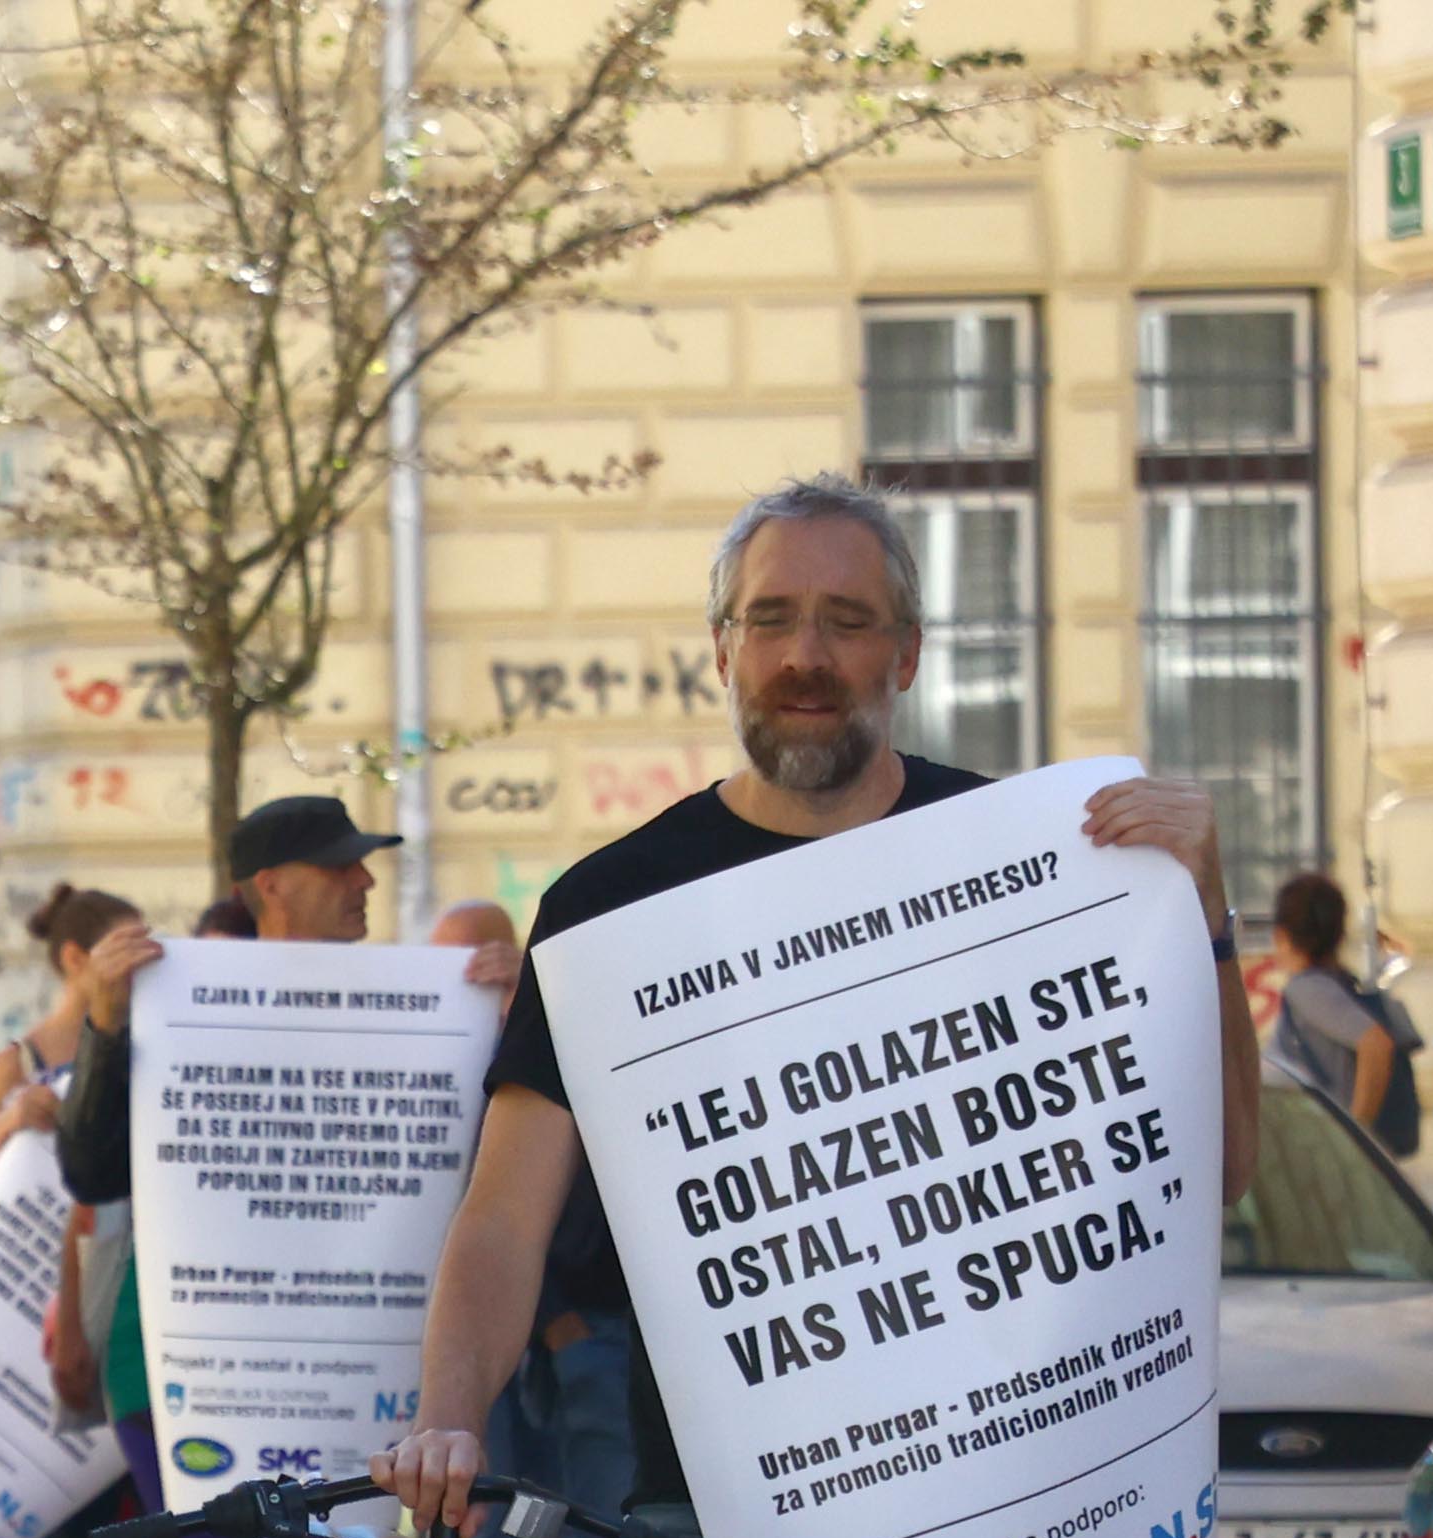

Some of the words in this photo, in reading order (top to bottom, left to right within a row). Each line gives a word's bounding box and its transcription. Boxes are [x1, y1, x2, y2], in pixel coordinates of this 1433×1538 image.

[192, 987, 250, 1006] IZJAVA
[257, 988, 266, 1006] V
[272, 990, 341, 1009] JAVNEM
[348, 992, 440, 1012] INTERESU?
[633, 958, 739, 1018] IZJAVA
[741, 948, 762, 979] V
[773, 906, 894, 971] JAVNEM
[898, 850, 1058, 930] INTERESU?
[162, 1088, 184, 1110] ŠE
[192, 1091, 274, 1113] POSEBEJ
[280, 1095, 304, 1114] NA
[312, 1097, 359, 1116] TISTE
[368, 1098, 377, 1116] V
[178, 1118, 201, 1137] DA
[210, 1119, 231, 1138] SE
[239, 1120, 314, 1141] AKTIVNO
[322, 1122, 398, 1142] UPREMO
[406, 1125, 449, 1144] LGBT
[280, 1069, 304, 1087] NA
[312, 1070, 344, 1089] VSE
[645, 1076, 769, 1153] “LEJ
[779, 994, 1020, 1115] GOLAZEN
[1029, 955, 1148, 1032] STE,
[675, 1102, 944, 1238] GOLAZEN
[951, 1033, 1147, 1148] BOSTE
[158, 1143, 258, 1165] IDEOLOGIJI
[267, 1147, 283, 1165] IN
[292, 1147, 400, 1169] ZAHTEVAMO
[198, 1170, 282, 1192] POPOLNO
[290, 1173, 307, 1193] IN
[315, 1173, 421, 1196] TAKOJŠNJO
[696, 1216, 881, 1310] OSTAL,
[886, 1138, 1096, 1248] DOKLER
[1104, 1107, 1171, 1174] SE
[723, 1302, 846, 1387] VAS
[856, 1269, 946, 1346] NE
[956, 1178, 1183, 1312] SPUCA.”
[757, 1436, 842, 1481] Urban
[845, 1403, 939, 1453] Purgar
[966, 1344, 1106, 1417] predsednik
[1110, 1308, 1183, 1361] društva
[771, 1488, 805, 1516] za
[809, 1443, 942, 1507] promocijo
[946, 1376, 1118, 1458] tradicionalnih
[1122, 1335, 1193, 1392] vrednot
